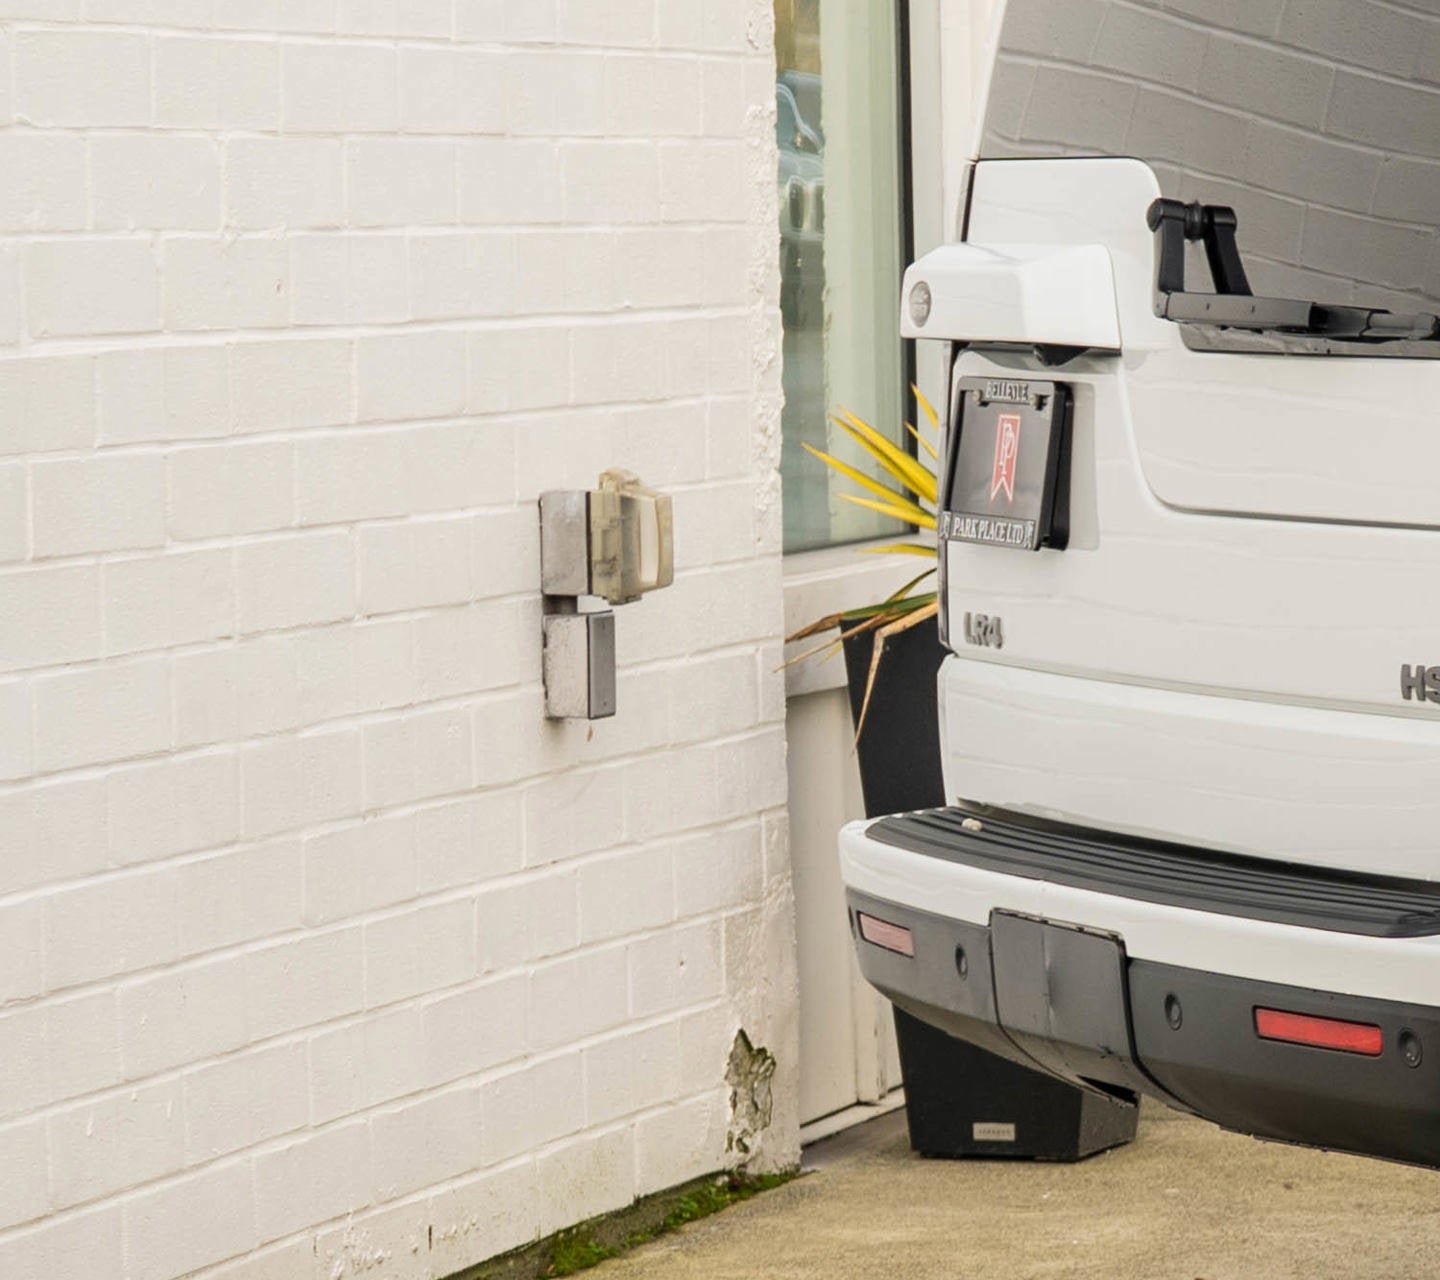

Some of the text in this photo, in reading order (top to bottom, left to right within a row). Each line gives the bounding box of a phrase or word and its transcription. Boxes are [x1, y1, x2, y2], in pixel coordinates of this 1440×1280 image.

[952, 516, 978, 539] PARK
[978, 519, 1006, 542] PLACE
[1006, 523, 1024, 544] LTD
[963, 611, 1003, 650] LR4
